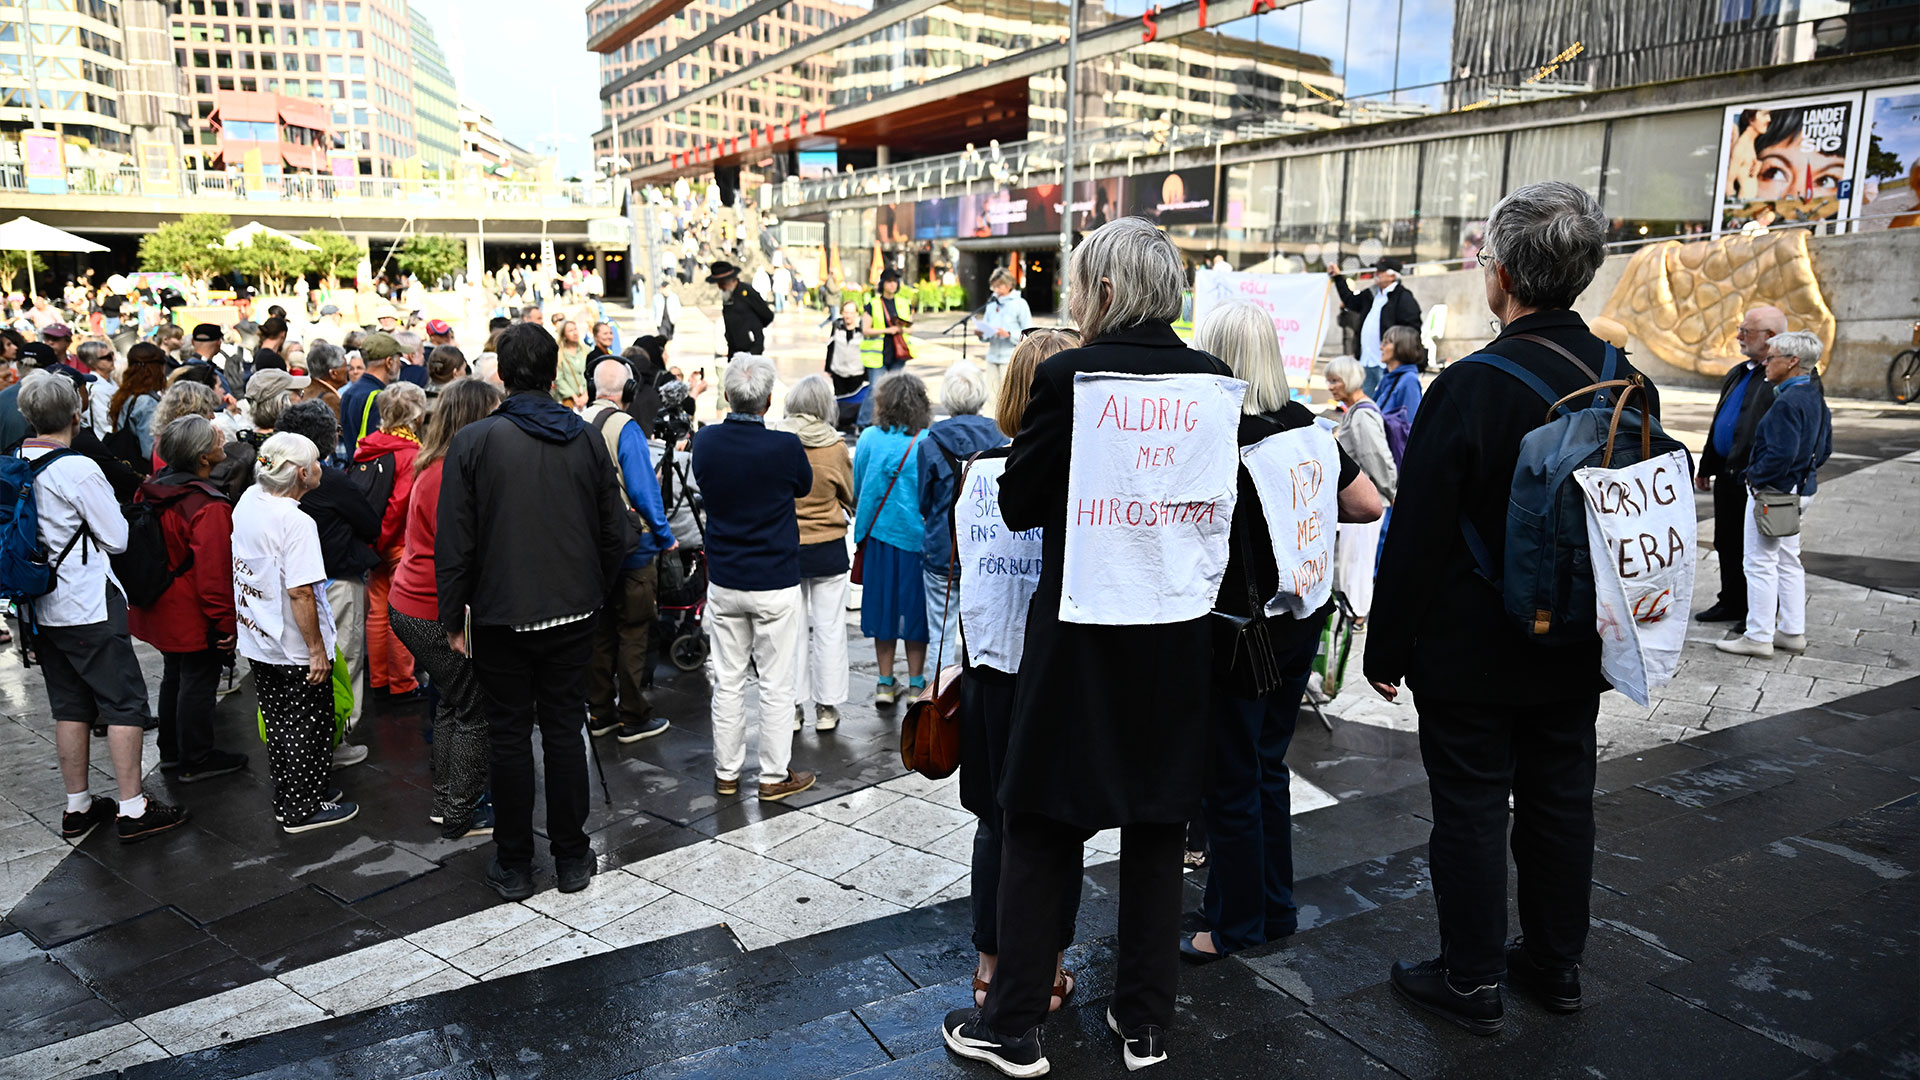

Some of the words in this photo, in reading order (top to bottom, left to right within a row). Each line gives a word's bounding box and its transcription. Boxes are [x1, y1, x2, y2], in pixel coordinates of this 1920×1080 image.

[1802, 106, 1847, 125] LANDET
[1802, 121, 1844, 139] UTOM
[1800, 136, 1842, 153] SIG
[1097, 394, 1199, 432] ALDRIG
[1136, 445, 1175, 469] MER
[1077, 497, 1216, 527] HIROSHIMA
[1608, 526, 1684, 579] ERA
